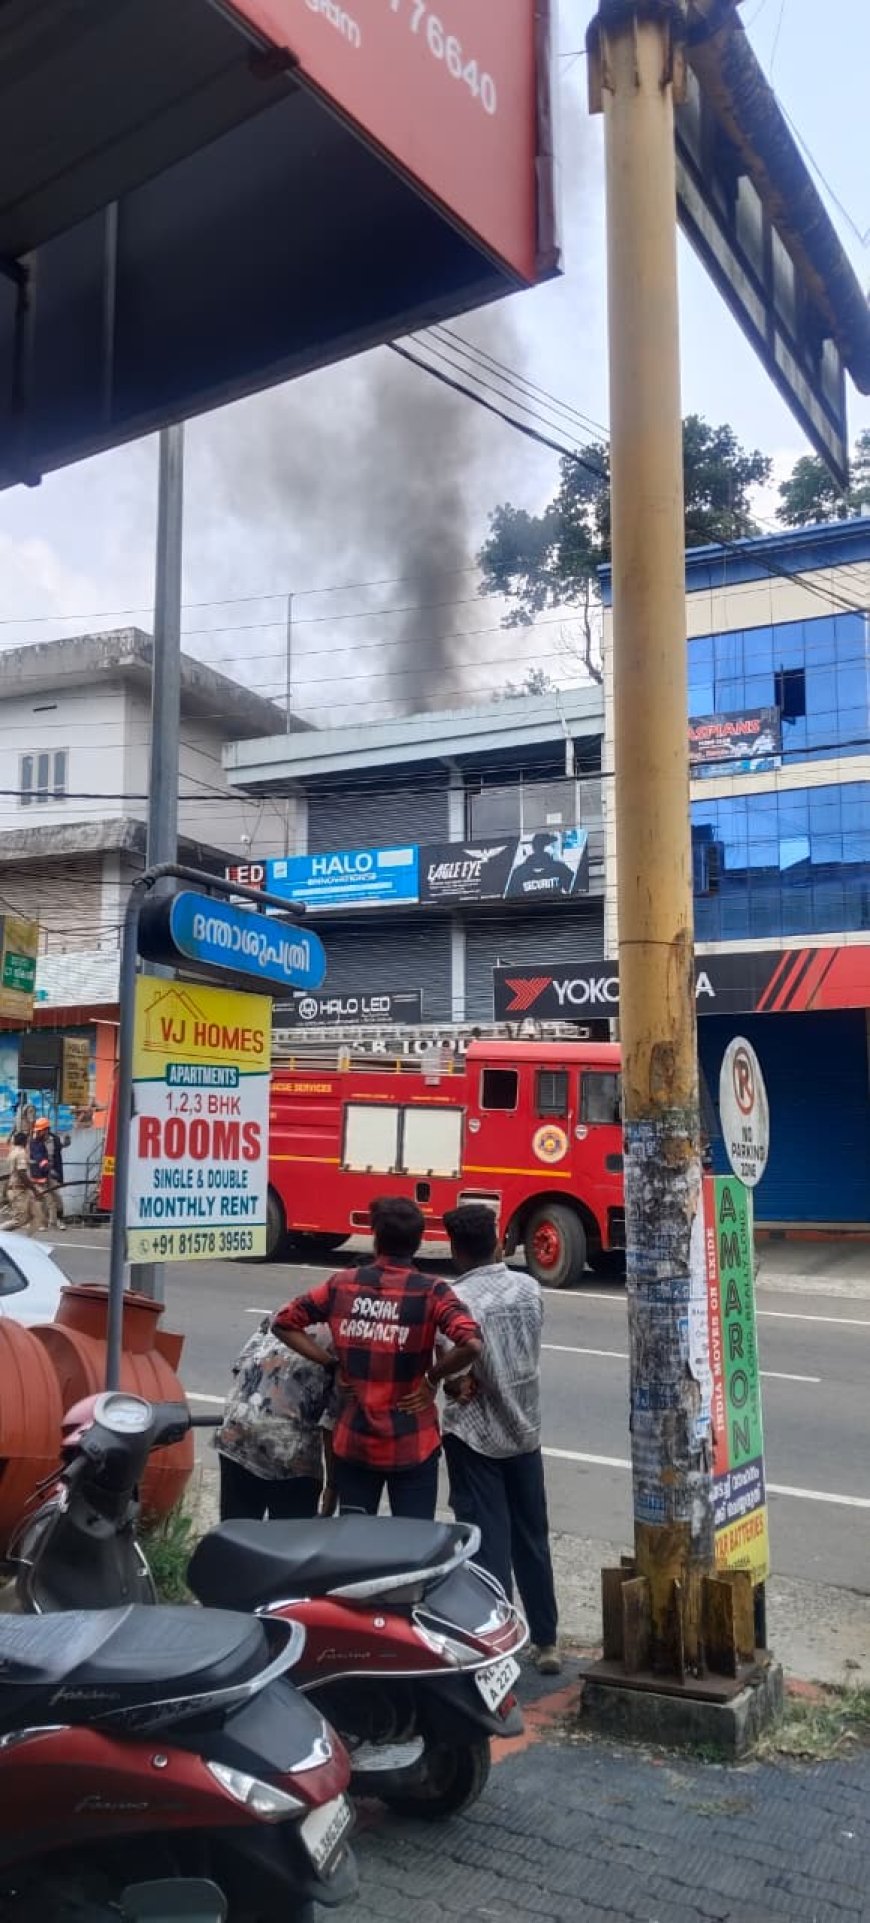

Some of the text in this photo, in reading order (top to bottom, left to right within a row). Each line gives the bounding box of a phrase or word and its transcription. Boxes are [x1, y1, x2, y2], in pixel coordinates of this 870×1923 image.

[312, 853, 373, 876] HALO
[427, 860, 482, 882] EAGLE EYE
[319, 996, 390, 1015] HALO LED
[161, 1017, 264, 1054] VJ HOMES
[169, 1065, 237, 1085] APARTMENTS
[166, 1091, 241, 1115] 1,2,3 BHK
[138, 1115, 261, 1161] ROOMS
[153, 1168, 249, 1189] SINGLE & DOUBLE
[139, 1195, 260, 1218] MONTHLY RENT
[152, 1231, 253, 1255] +91 81578 39563
[706, 1227, 717, 1281] EXIDE
[351, 1297, 400, 1320] SOCIAL
[719, 1185, 751, 1460] AMARON
[711, 1315, 722, 1377] MOVES
[714, 1381, 724, 1431] INDIA
